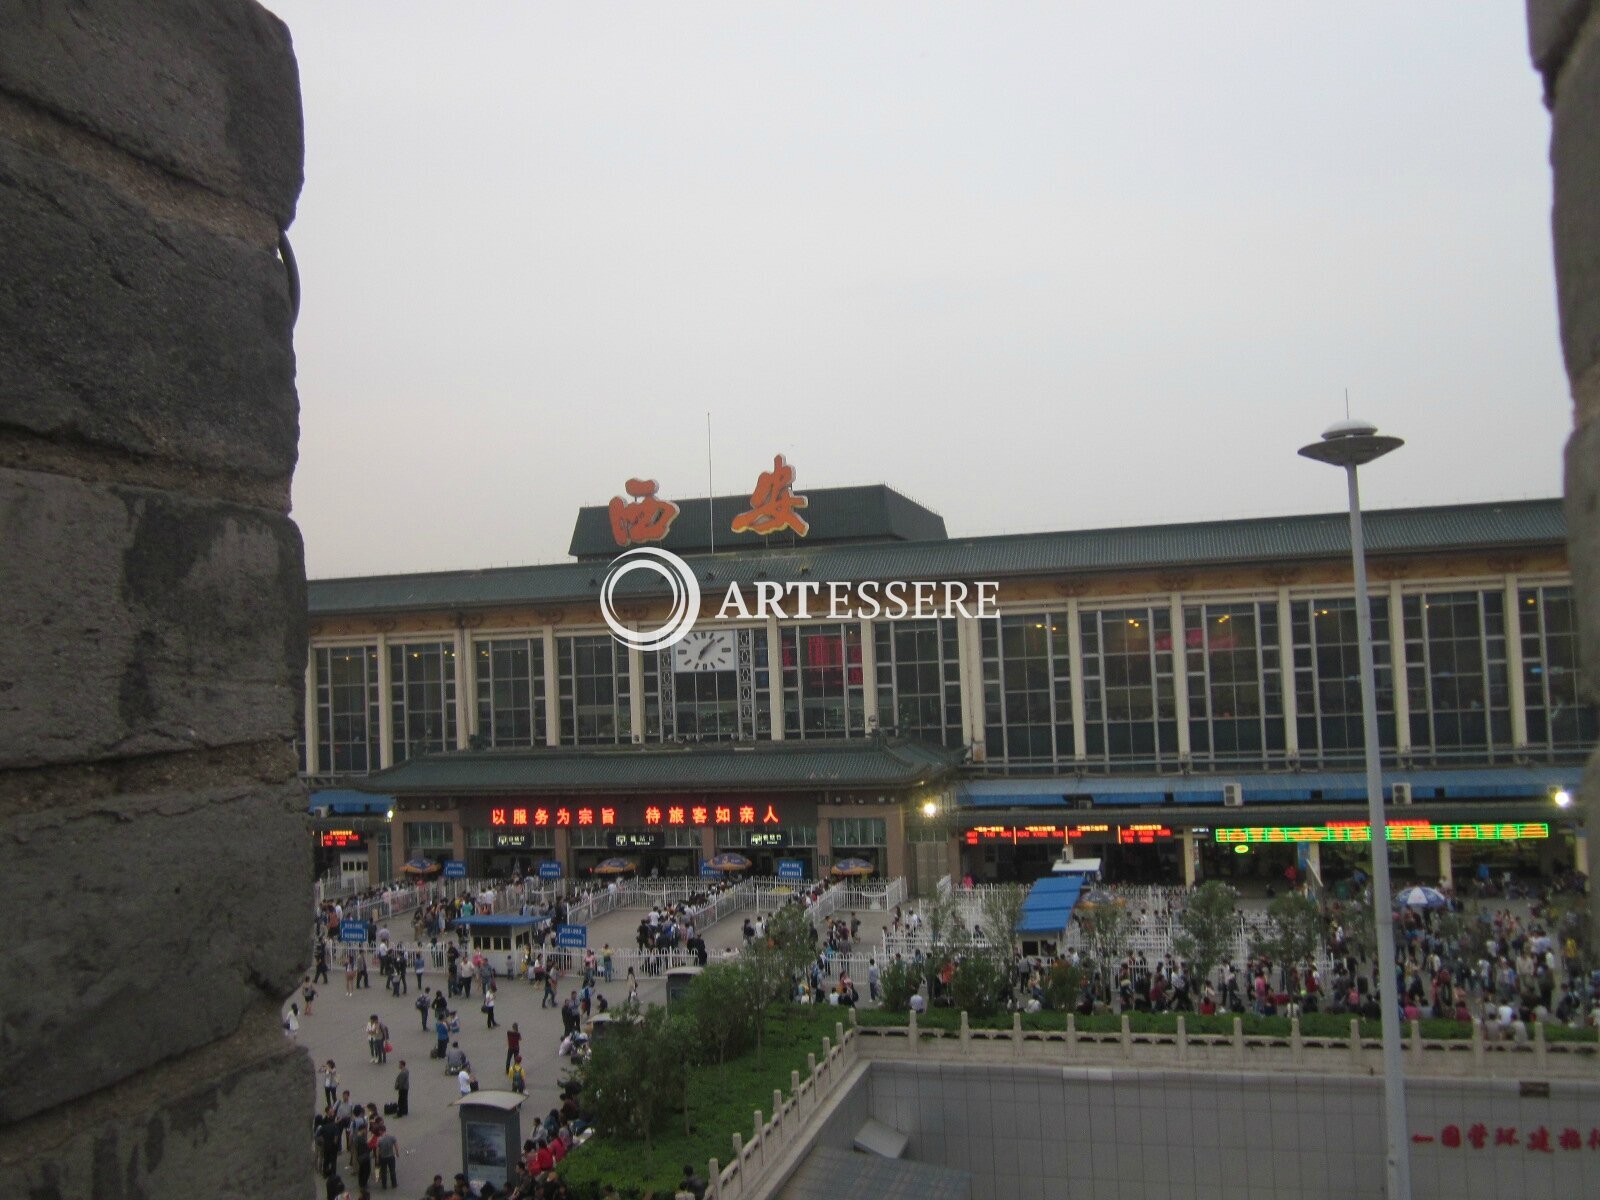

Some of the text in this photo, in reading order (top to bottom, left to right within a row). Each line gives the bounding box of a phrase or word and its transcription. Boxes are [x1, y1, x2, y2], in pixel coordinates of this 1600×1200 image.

[608, 454, 809, 545] 西安
[491, 804, 780, 826] 以服务为宗旨 待旅客如亲人
